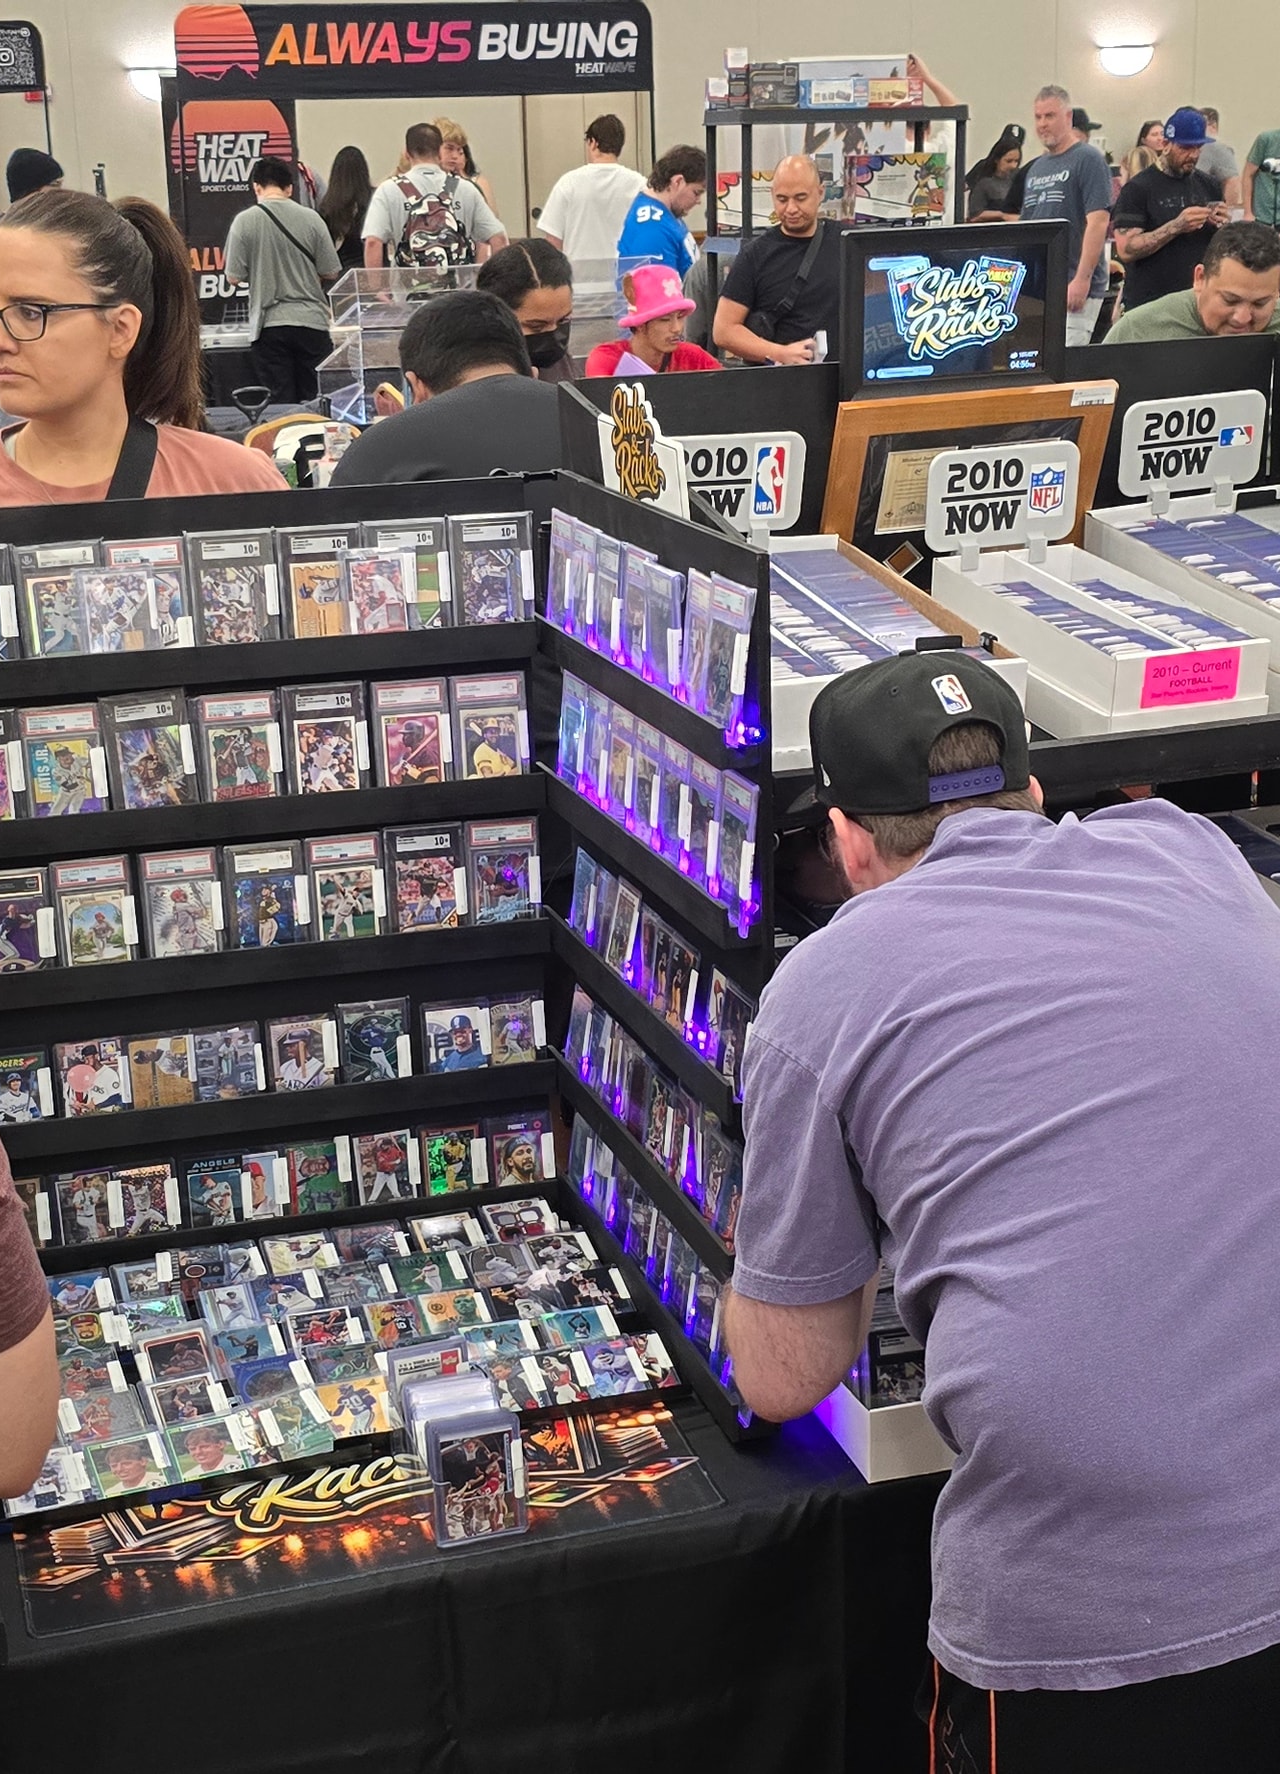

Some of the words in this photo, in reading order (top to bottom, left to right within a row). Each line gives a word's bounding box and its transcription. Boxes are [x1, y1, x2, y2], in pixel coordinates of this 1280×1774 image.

[264, 20, 472, 66] ALWAYS
[477, 20, 639, 61] BUYING
[196, 132, 267, 159] HEAT
[636, 204, 664, 223] 97
[906, 261, 1002, 318] Slabs
[909, 295, 1017, 355] Racks
[611, 386, 654, 447] Slabs
[1143, 406, 1216, 442] 2010
[616, 439, 666, 500] Racks
[1140, 445, 1213, 481] NOW
[947, 458, 1024, 494] 2010
[755, 500, 773, 512] NBA
[1032, 486, 1060, 509] NFL
[945, 499, 1022, 536] NOW
[417, 533, 427, 543] 10
[501, 527, 511, 537] 10
[243, 544, 254, 554] 10
[331, 539, 342, 549] 10
[1152, 664, 1179, 679] 2010
[1192, 658, 1233, 675] Current
[1169, 675, 1213, 689] FOOTBALL
[155, 704, 166, 714] 10
[335, 695, 346, 706] 10
[38, 766, 52, 795] TATIS
[434, 836, 445, 846] 10
